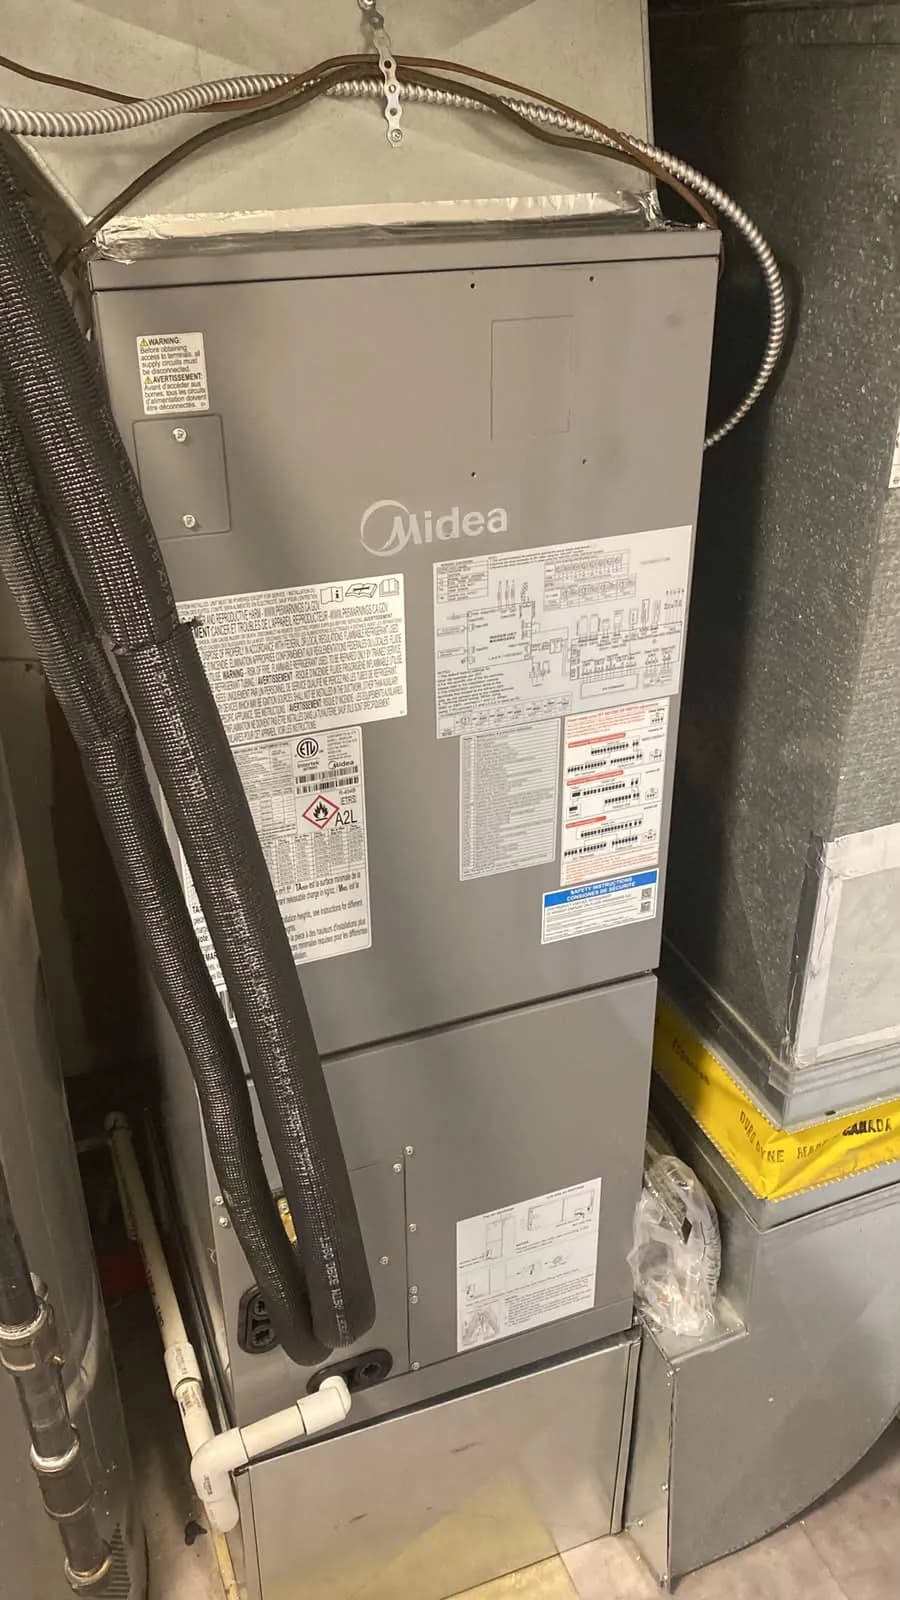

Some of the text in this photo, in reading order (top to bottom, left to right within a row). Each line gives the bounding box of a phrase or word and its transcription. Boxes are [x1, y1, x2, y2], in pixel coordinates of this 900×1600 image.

[149, 337, 181, 345] WARNING:
[360, 500, 508, 557] Midea
[335, 810, 357, 826] A2L
[842, 1118, 892, 1136] CANADA
